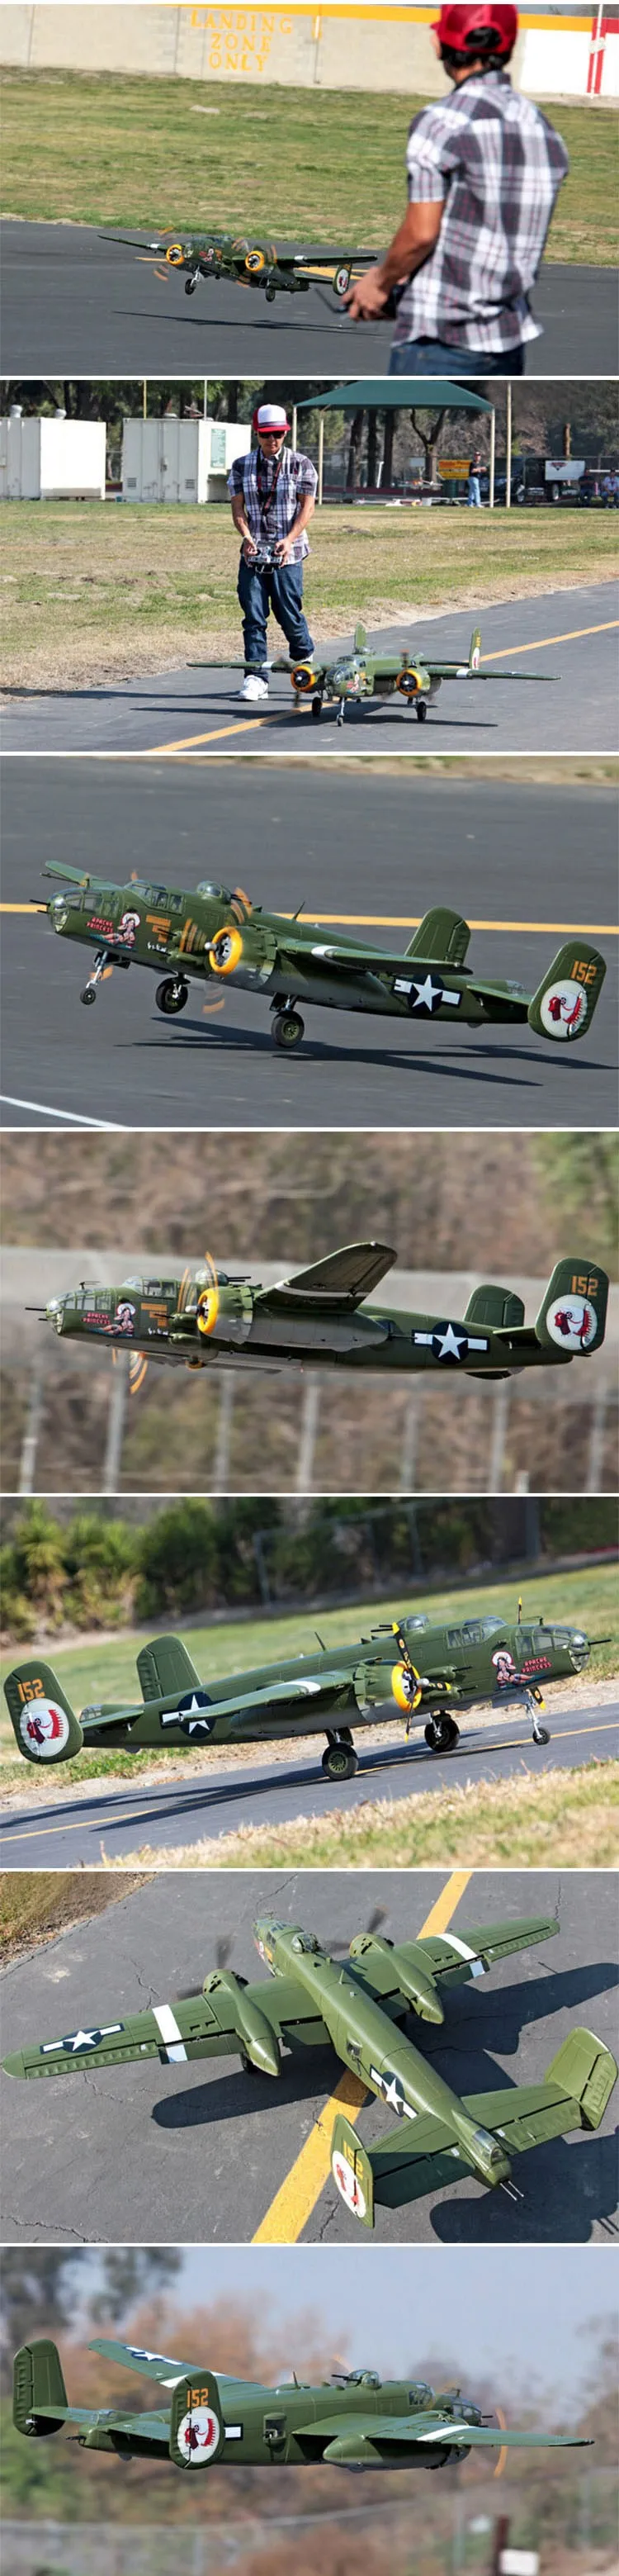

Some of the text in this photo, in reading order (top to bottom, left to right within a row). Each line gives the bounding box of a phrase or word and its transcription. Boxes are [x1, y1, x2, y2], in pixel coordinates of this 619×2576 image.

[191, 9, 292, 34] LANDING
[210, 31, 272, 53] ZONE
[209, 52, 267, 72] ONLY
[570, 960, 598, 985] 152
[572, 1275, 598, 1297] 152
[523, 1655, 548, 1668] APACHE
[17, 1677, 45, 1703] 152
[343, 2140, 364, 2181] 152
[187, 2387, 209, 2408] 152
